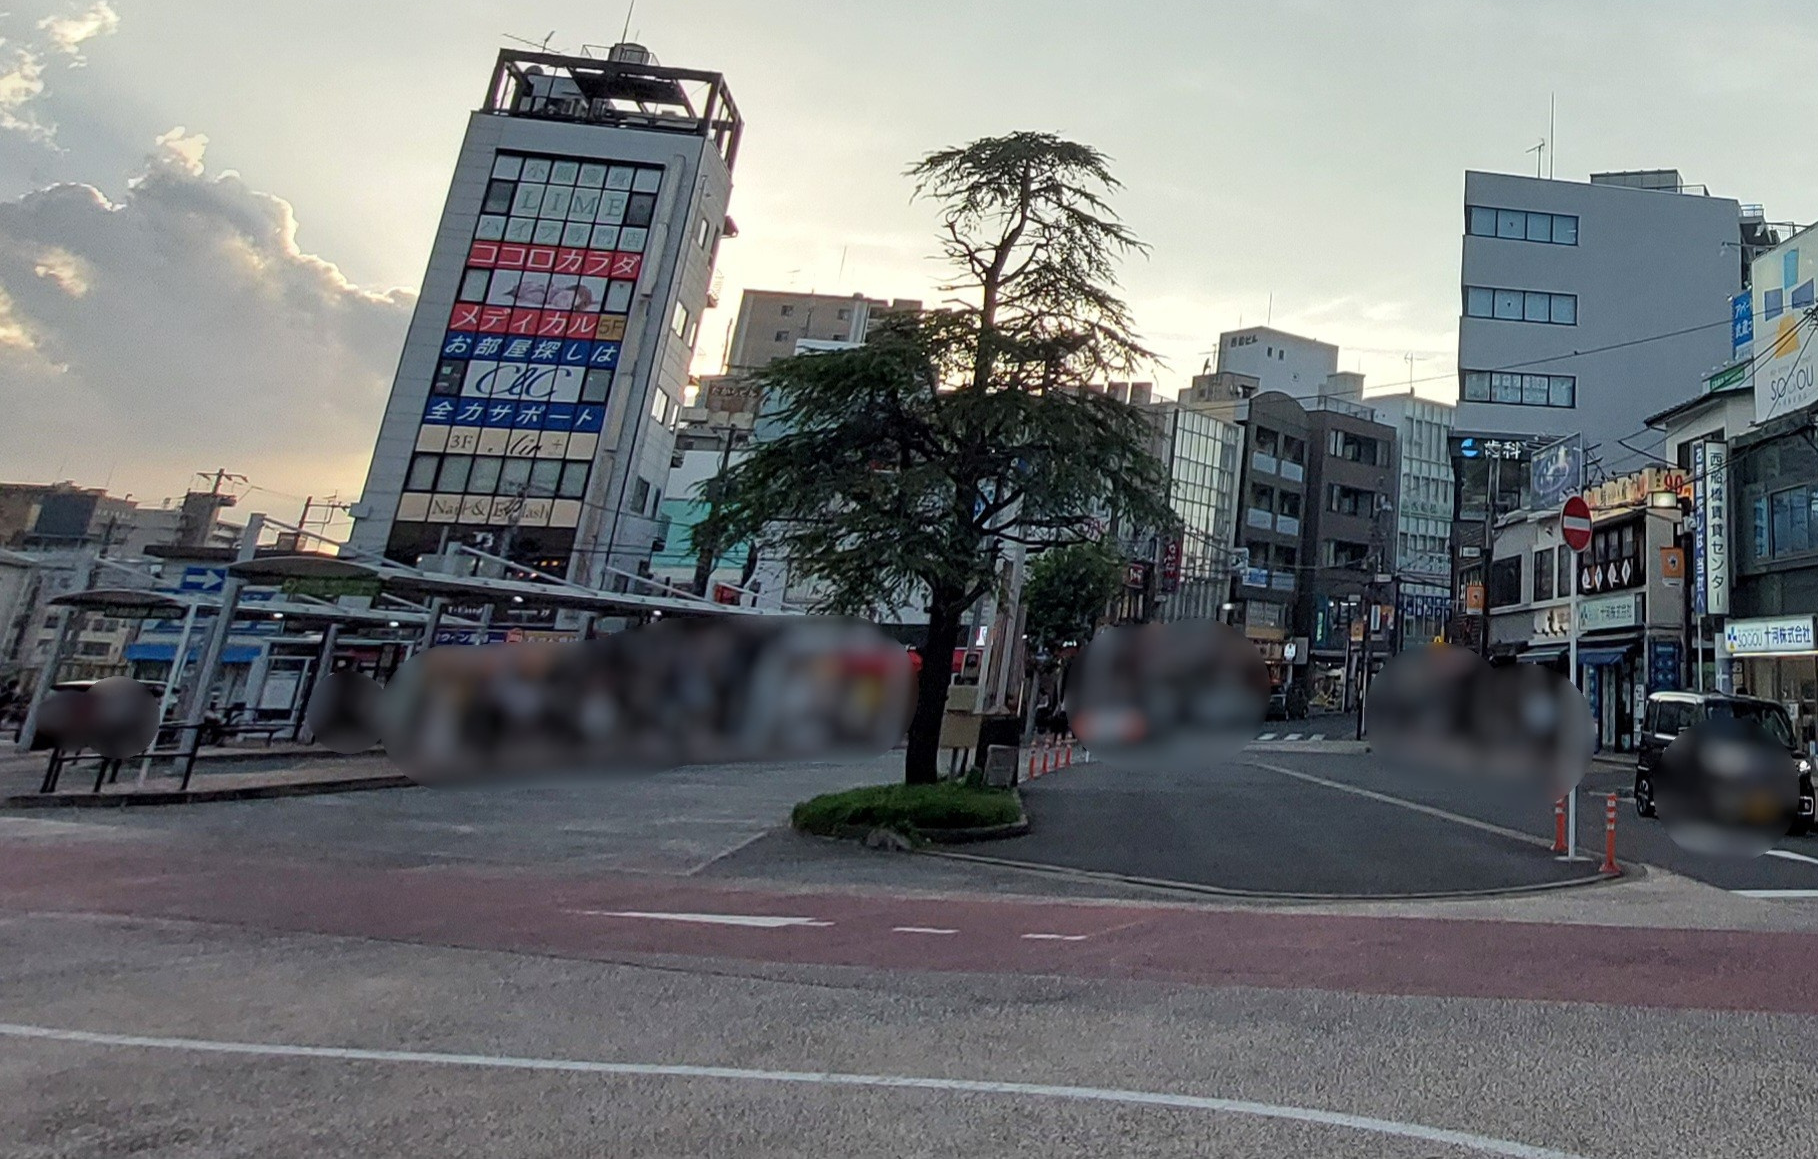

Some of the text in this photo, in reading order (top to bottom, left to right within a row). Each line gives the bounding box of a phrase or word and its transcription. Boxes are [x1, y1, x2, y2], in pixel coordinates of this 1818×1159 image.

[520, 193, 624, 217] LIME
[470, 243, 642, 275] ココロカラダ
[451, 307, 596, 331] メディカル
[599, 318, 625, 335] 5F
[444, 335, 617, 362] お部屋探しは
[425, 400, 595, 426] 全力サポート
[450, 433, 473, 449] 3F
[1484, 439, 1521, 459] 歯科
[472, 499, 486, 516] &
[492, 500, 550, 521] Elash
[1709, 452, 1725, 606] 西船橋賃貸センター
[1764, 624, 1811, 647] 十河株式会社
